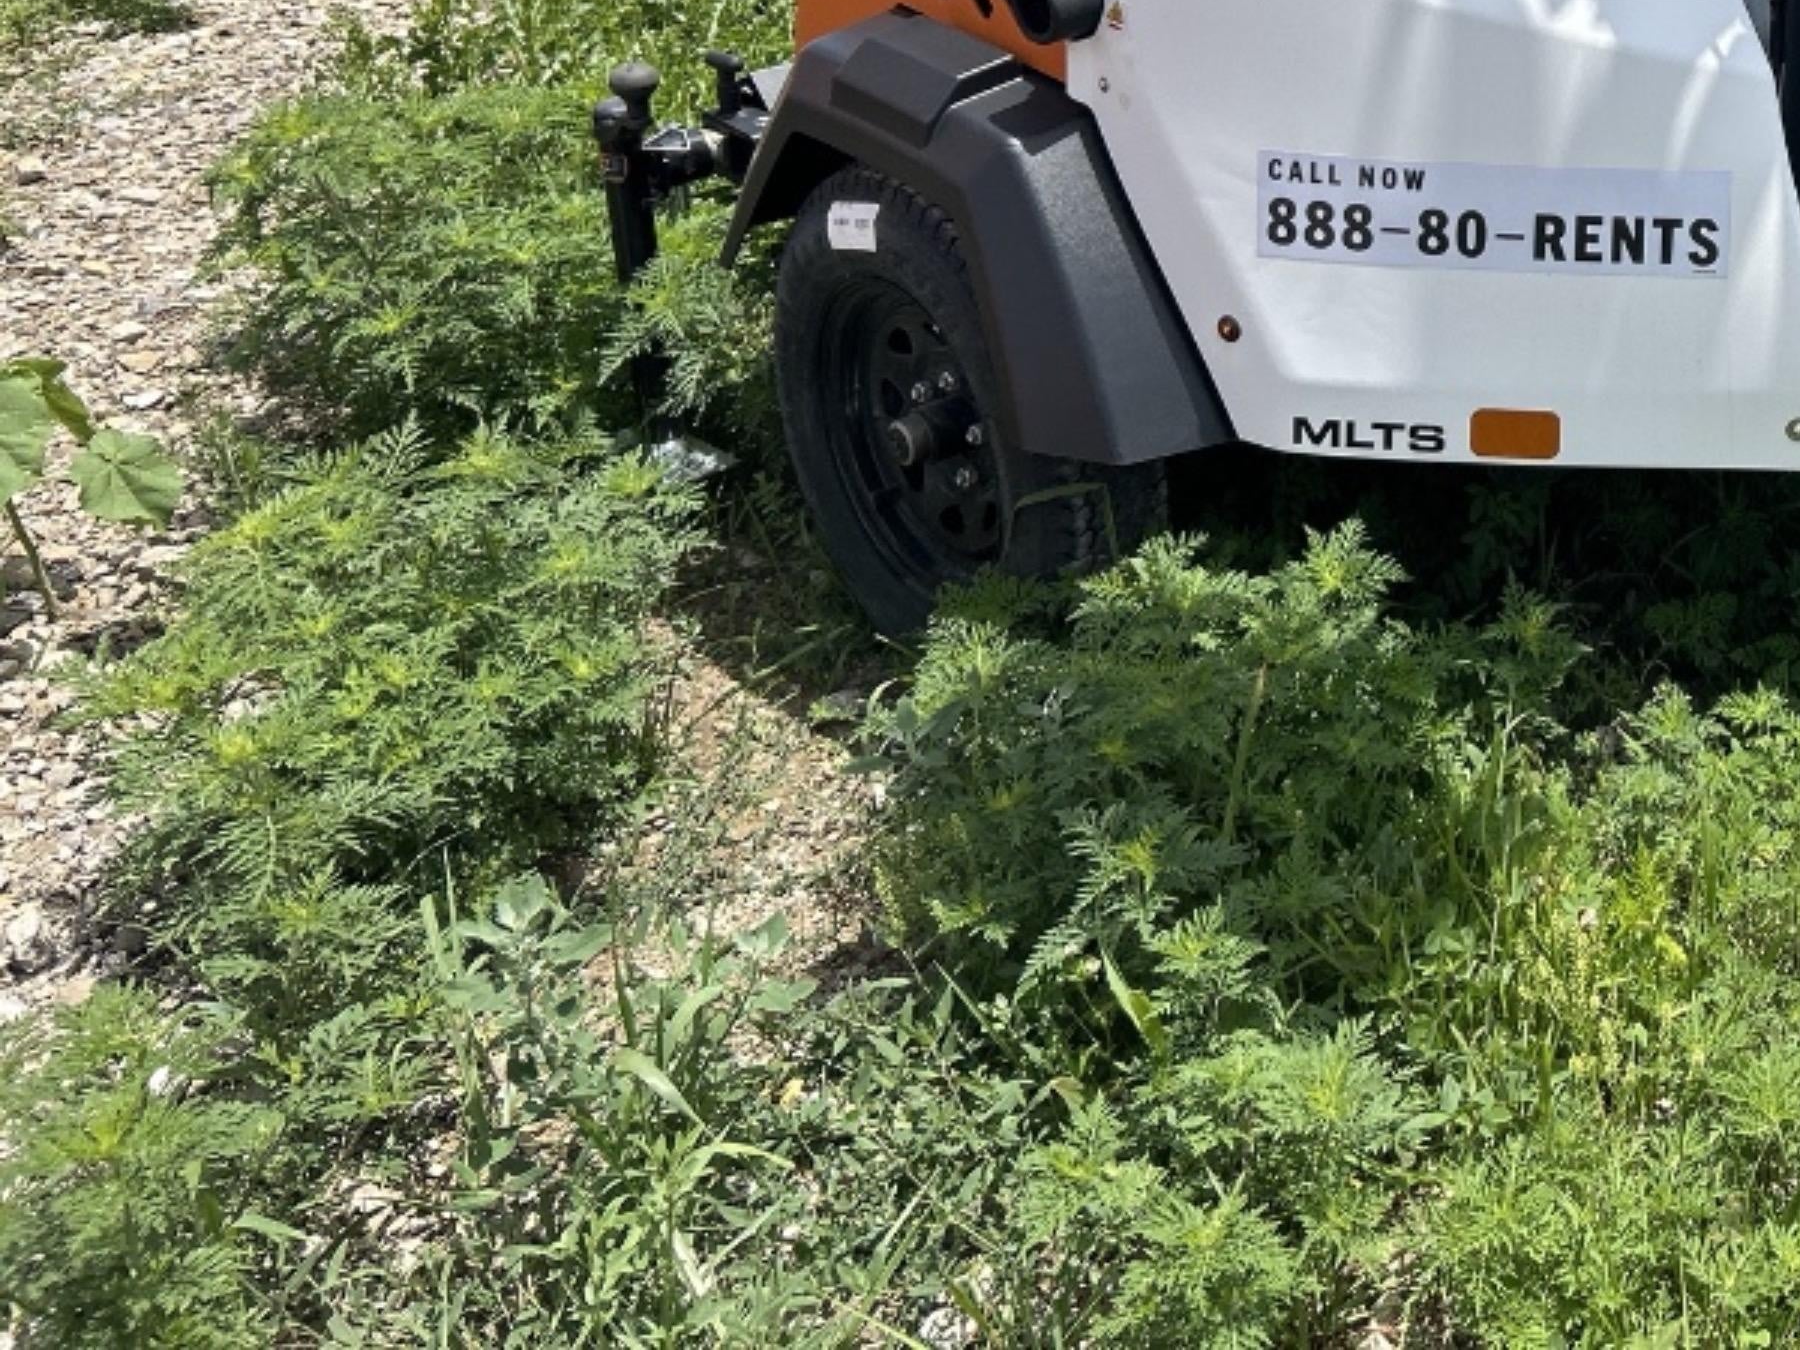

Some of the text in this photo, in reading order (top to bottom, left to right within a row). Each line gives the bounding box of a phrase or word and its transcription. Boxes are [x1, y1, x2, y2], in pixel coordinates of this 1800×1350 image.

[1268, 158, 1426, 192] CALL NOW
[1292, 415, 1446, 453] MLTS
